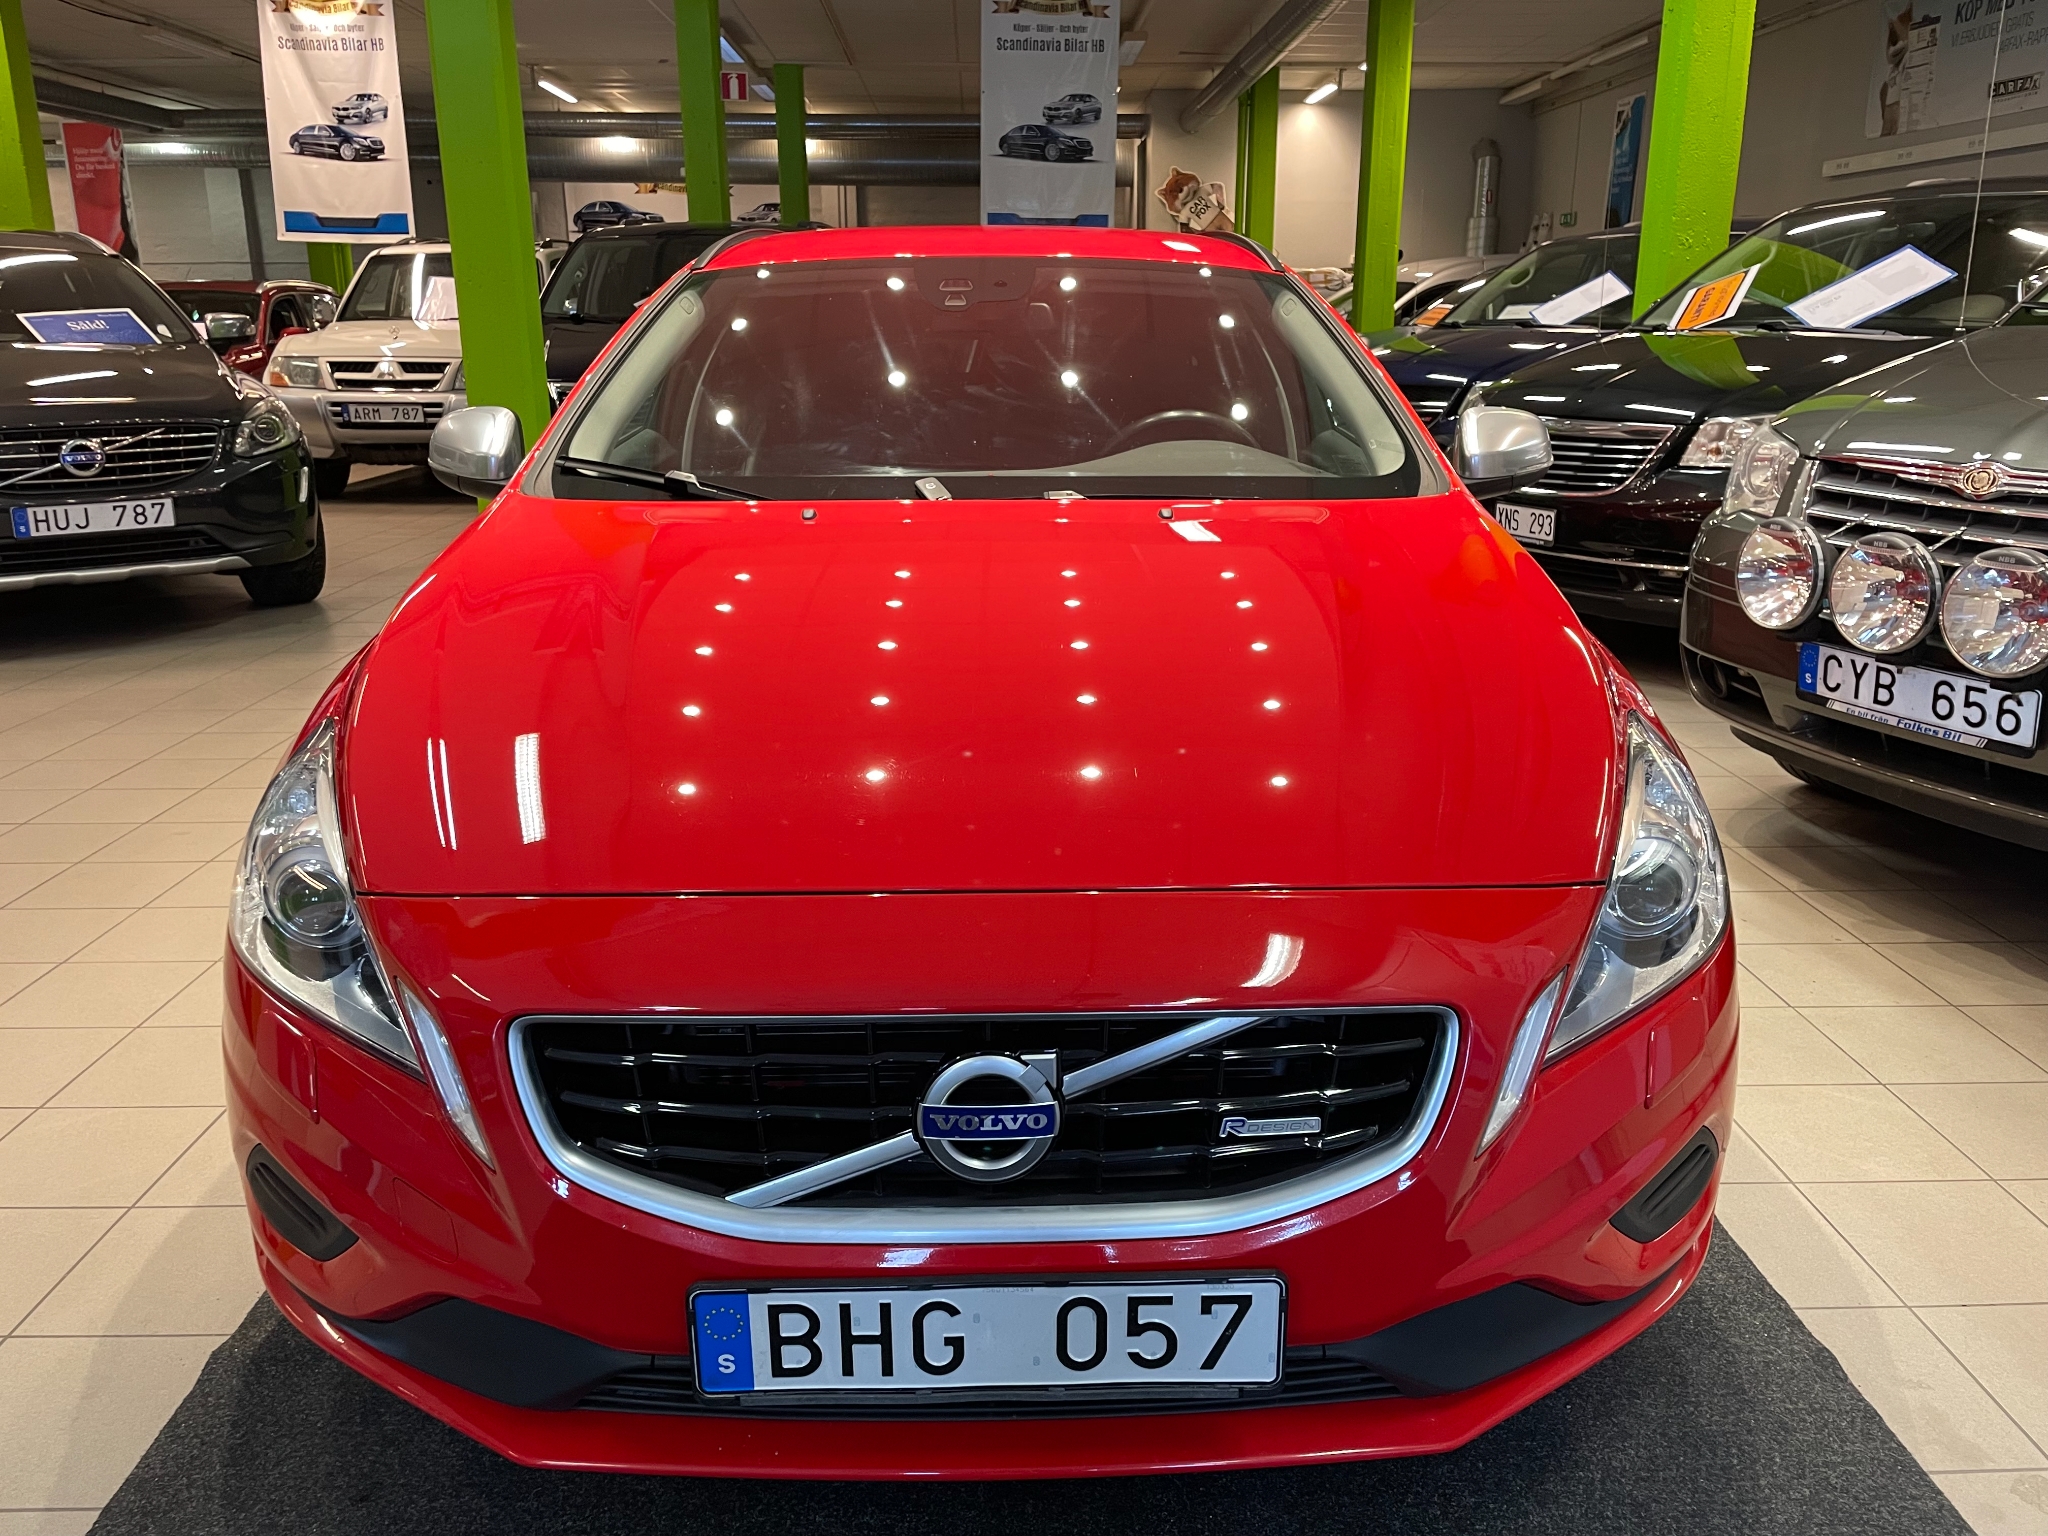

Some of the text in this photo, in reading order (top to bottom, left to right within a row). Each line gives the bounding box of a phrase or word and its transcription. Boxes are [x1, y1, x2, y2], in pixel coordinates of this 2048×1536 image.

[278, 35, 385, 52] Scandinavia Bilar HB
[996, 36, 1105, 53] Scandinavia Bilar HB
[1989, 74, 2041, 98] CARFAX
[1189, 195, 1206, 214] CAR
[1195, 203, 1212, 220] FOX
[66, 320, 110, 331] Såld!
[354, 407, 382, 421] ARM
[391, 407, 419, 421] 787
[33, 507, 90, 533] HUJ
[112, 502, 165, 527] 787
[1498, 506, 1553, 536] XNS 293
[1805, 654, 2024, 736] S CYB 656
[1857, 709, 1869, 718] bil
[1896, 717, 1940, 736] Folkes
[1942, 730, 1962, 742] Bil
[930, 1113, 1048, 1131] VOLVO
[718, 1295, 1253, 1378] S BHG 057
